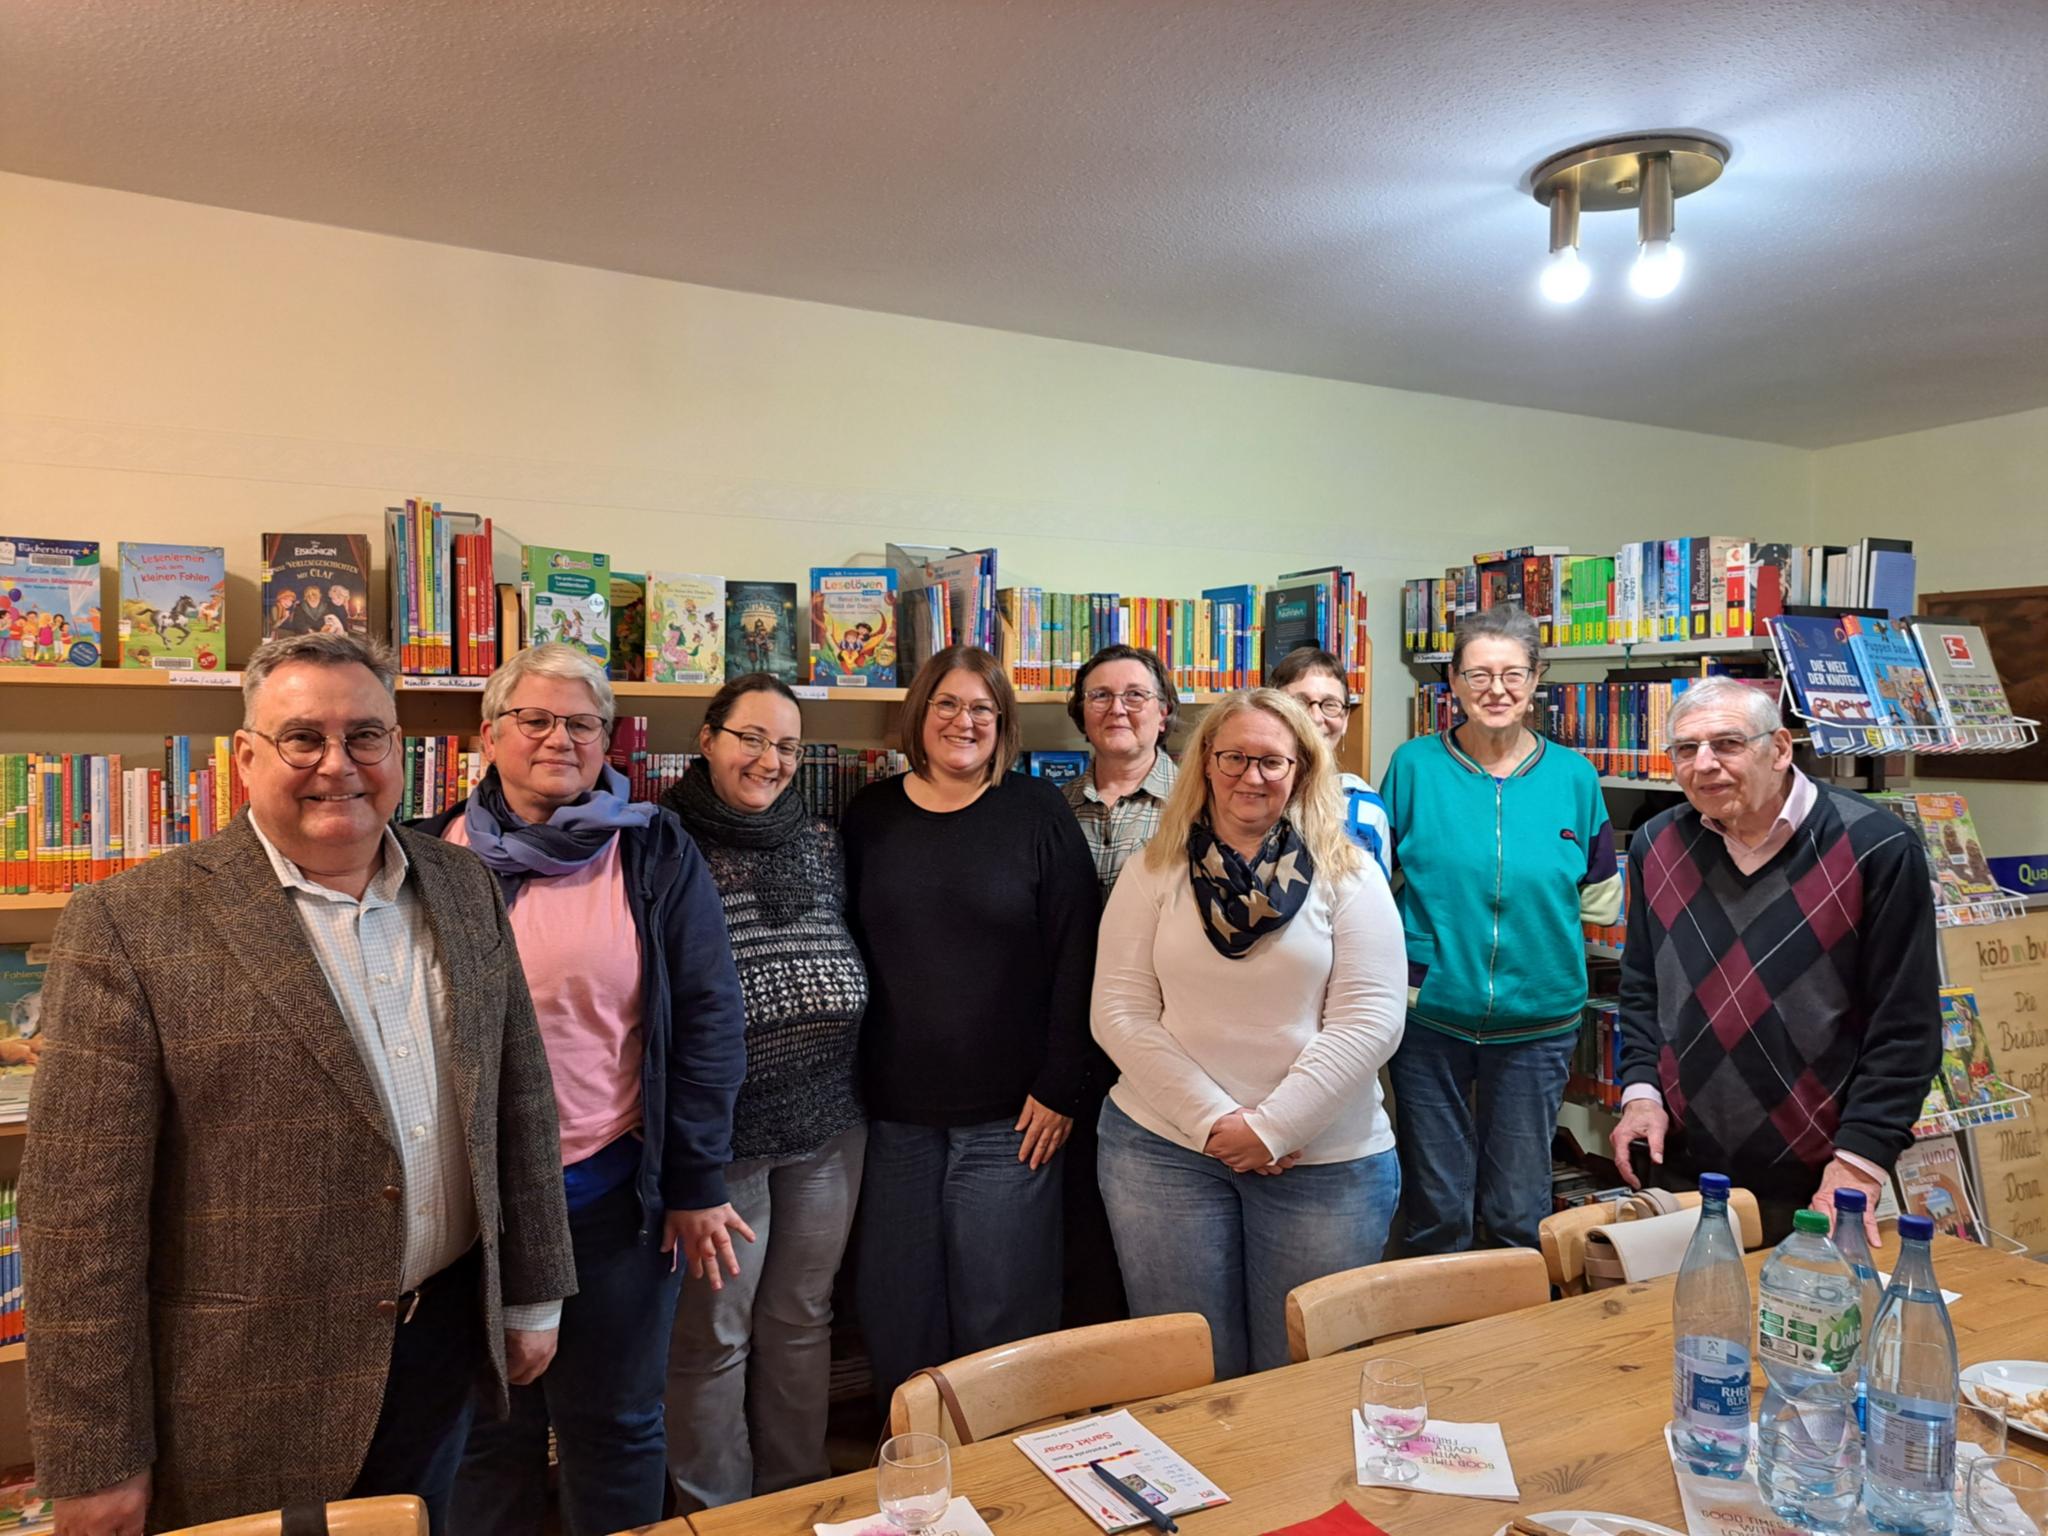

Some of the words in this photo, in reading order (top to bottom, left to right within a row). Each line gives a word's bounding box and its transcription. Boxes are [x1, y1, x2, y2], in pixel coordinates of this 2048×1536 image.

[18, 543, 80, 555] Büchersterne
[294, 547, 337, 556] EISKÖNIGIN
[142, 553, 204, 563] Lesenlernen
[142, 574, 177, 582] kleinen
[179, 573, 210, 582] Fohlen
[824, 578, 884, 590] Leselöwen
[1810, 659, 1827, 672] DIE
[1825, 660, 1849, 673] WELT
[1807, 672, 1828, 685] DER
[1826, 673, 1861, 687] KNOTEN
[1976, 939, 2010, 967] köb
[2013, 991, 2038, 1013] Die
[1075, 1432, 1114, 1447] Sankt
[1043, 1442, 1075, 1454] Goar
